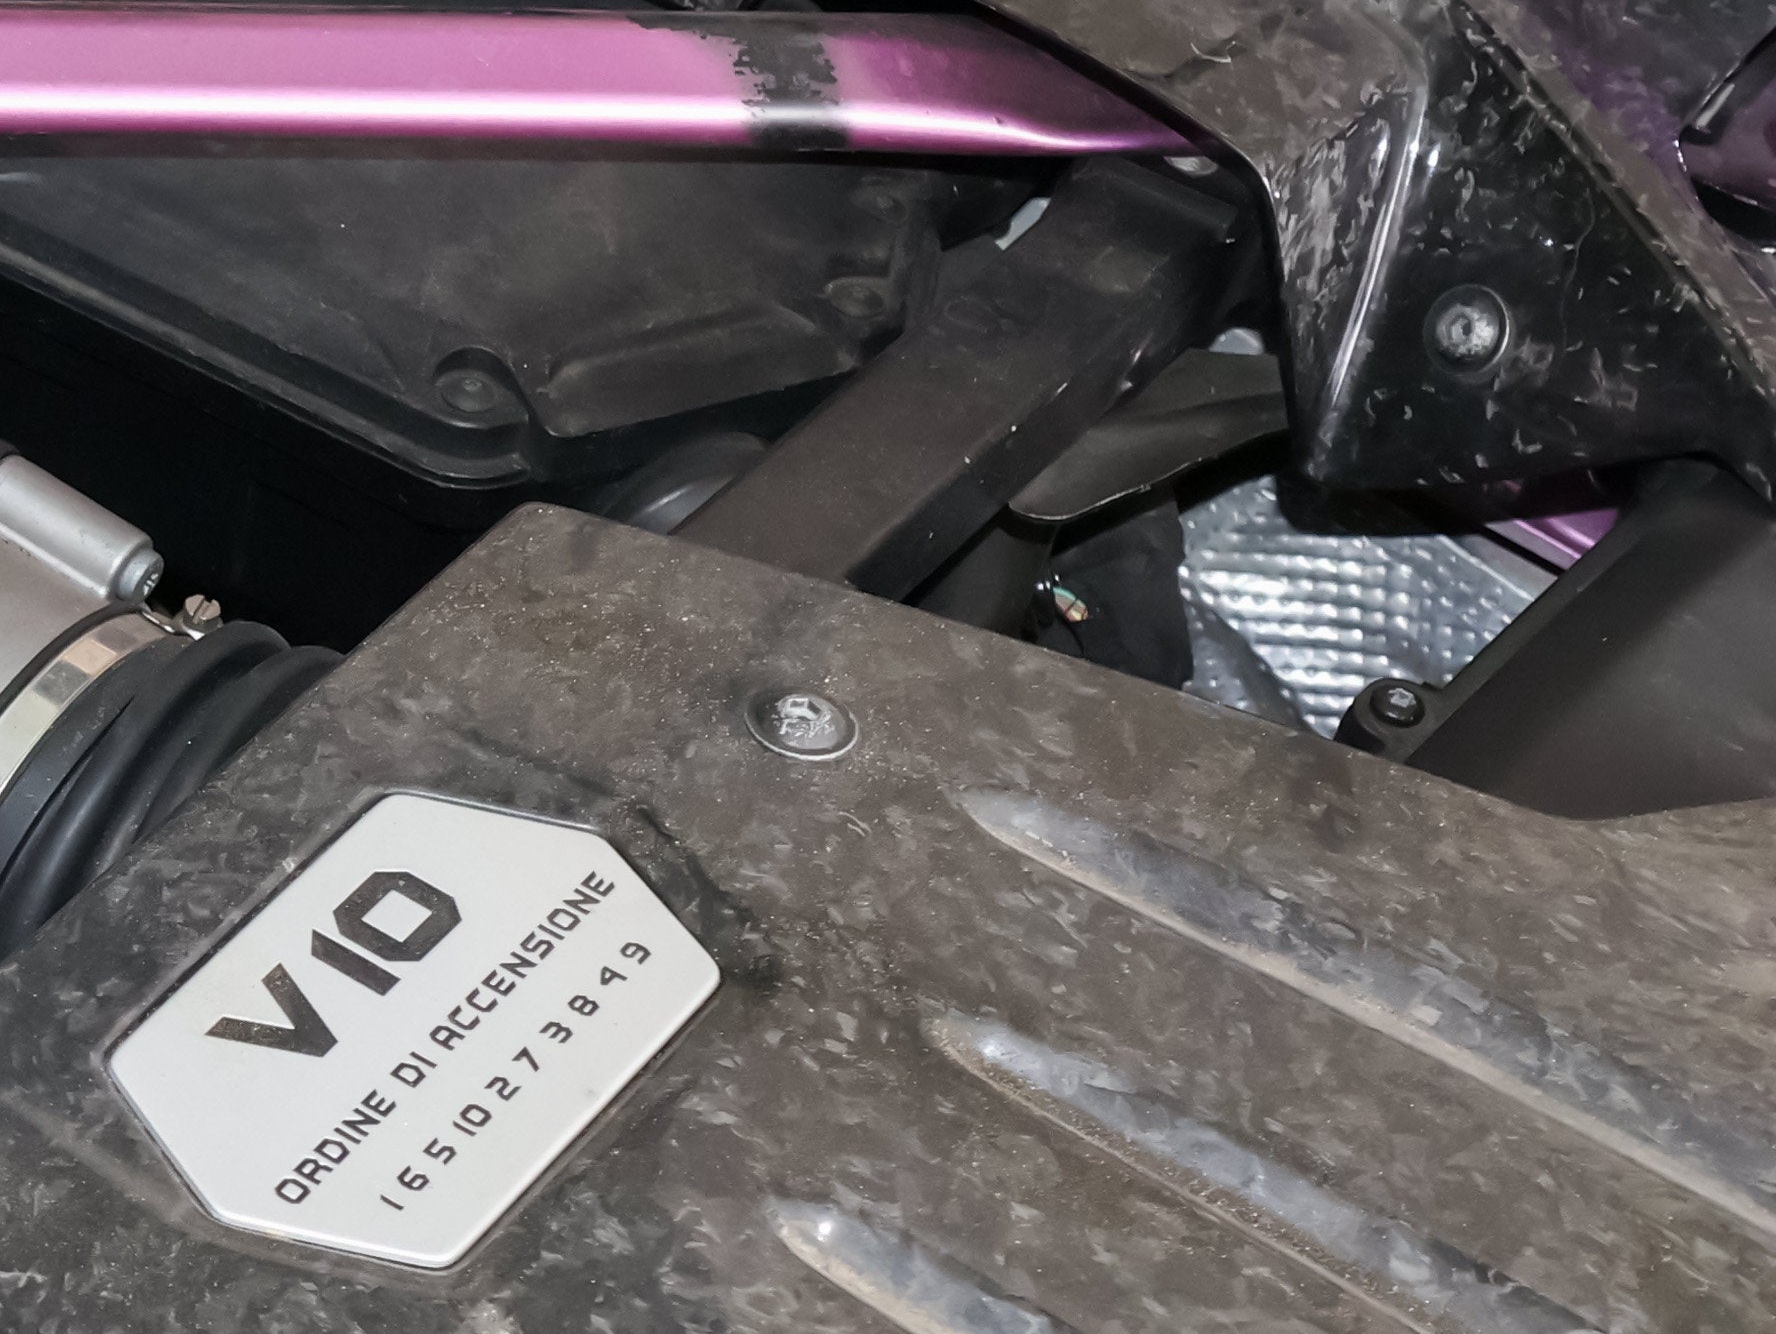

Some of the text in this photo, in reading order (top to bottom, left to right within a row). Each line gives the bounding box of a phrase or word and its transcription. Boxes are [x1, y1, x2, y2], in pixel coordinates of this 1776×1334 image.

[205, 871, 461, 1058] V10
[274, 870, 615, 1204] ORDINE DI ACCENSIONE
